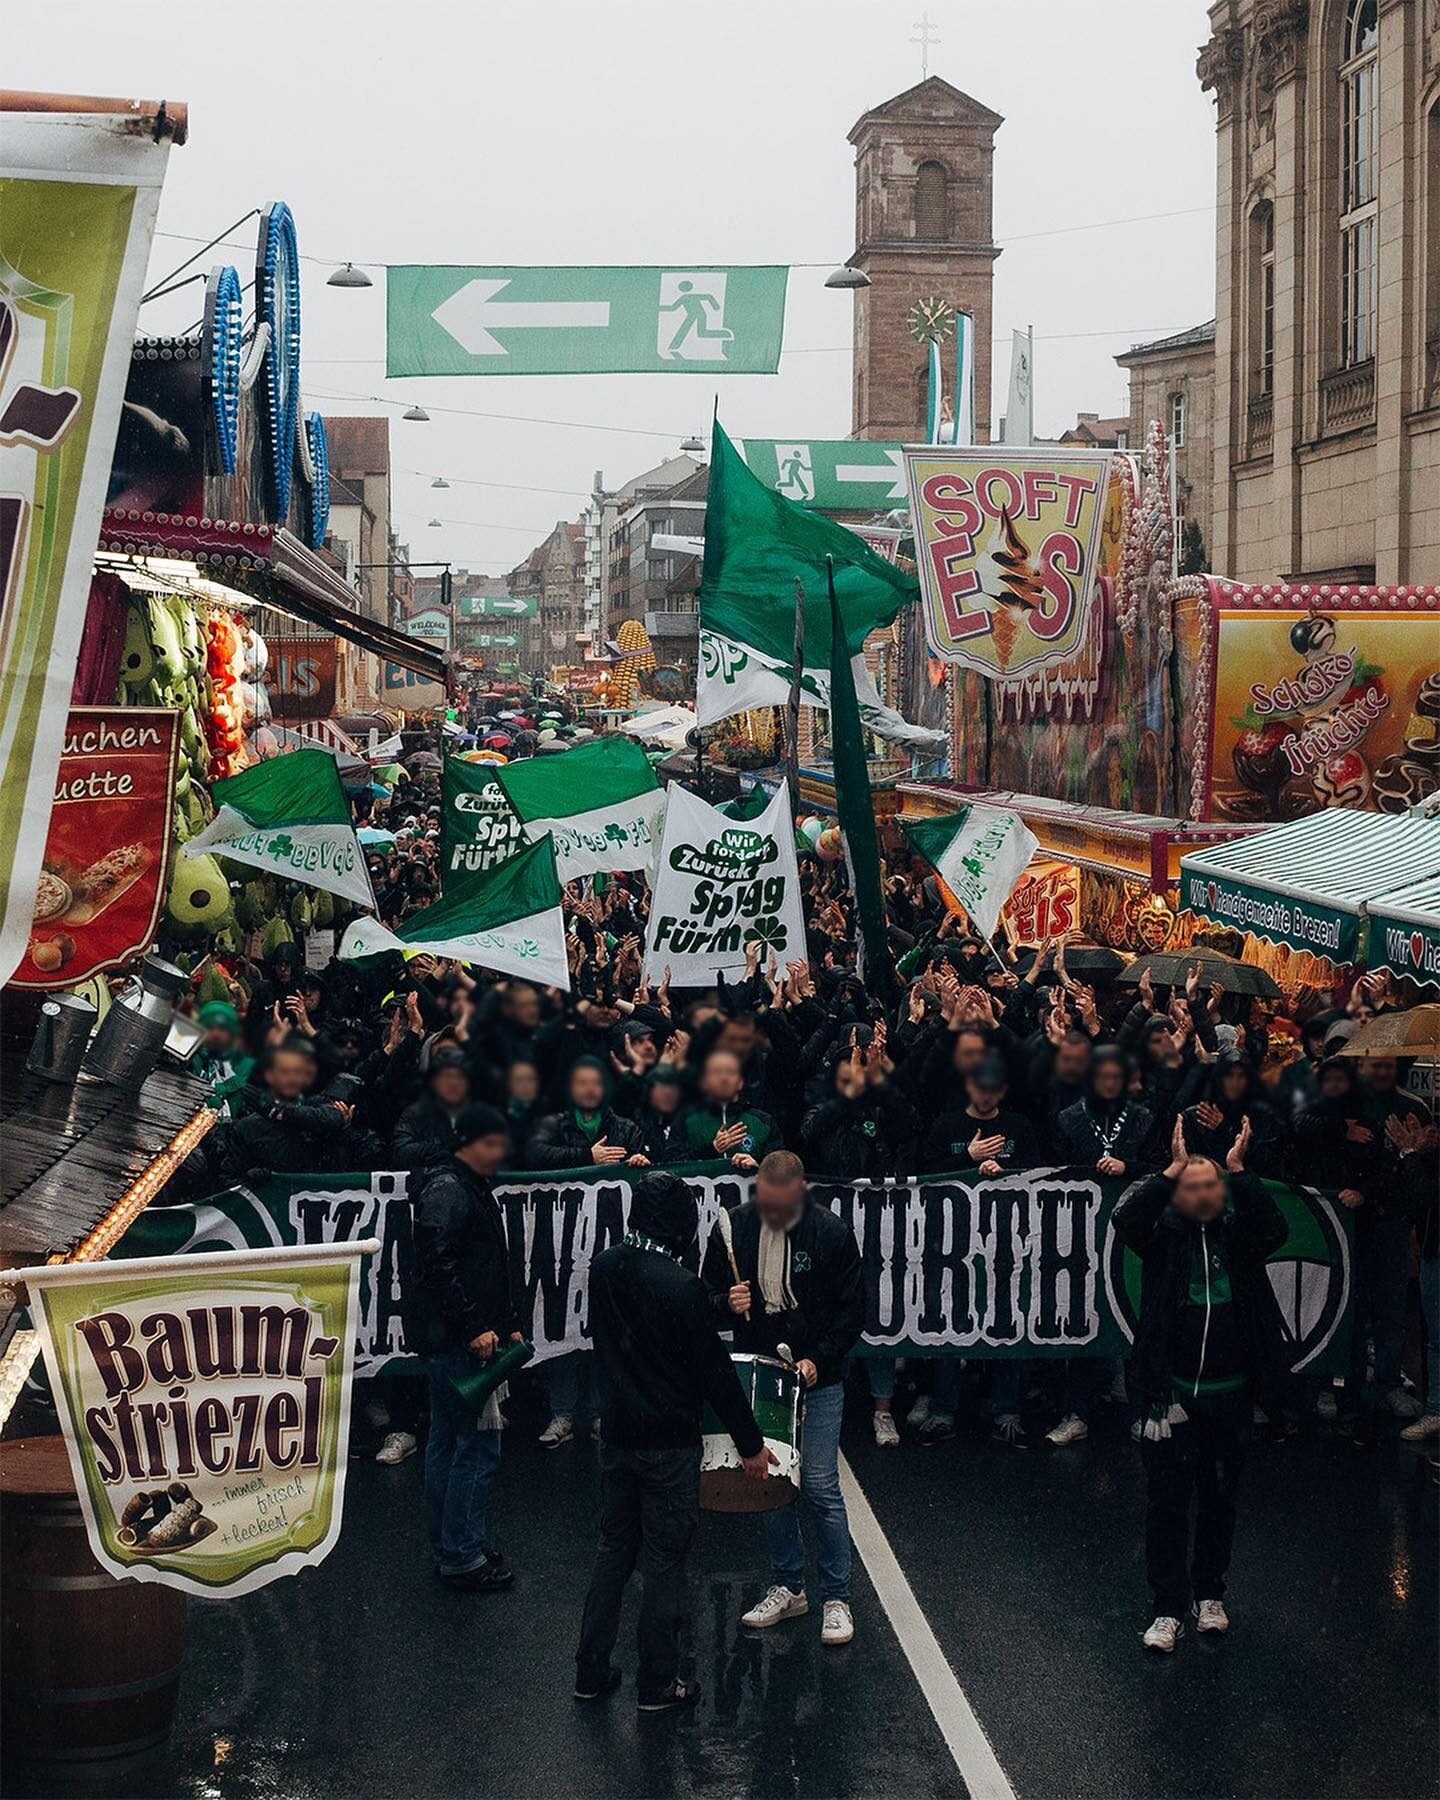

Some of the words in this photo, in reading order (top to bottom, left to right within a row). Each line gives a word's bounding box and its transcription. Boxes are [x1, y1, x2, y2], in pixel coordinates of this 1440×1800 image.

[922, 468, 1096, 538] SOFT
[409, 620, 447, 631] WELCOME
[1249, 645, 1358, 715] Schoko-
[1279, 686, 1389, 776] früchte
[677, 849, 752, 880] Zurück
[726, 832, 757, 848] Wir
[1011, 873, 1061, 912] SOFT
[1016, 884, 1077, 943] EIS
[1190, 878, 1209, 909] Wir
[1214, 884, 1291, 935] handgemachte
[1292, 907, 1341, 950] Brezen!
[1386, 928, 1411, 966] Wir
[75, 1304, 340, 1400] Baum-
[85, 1375, 328, 1485] striezel
